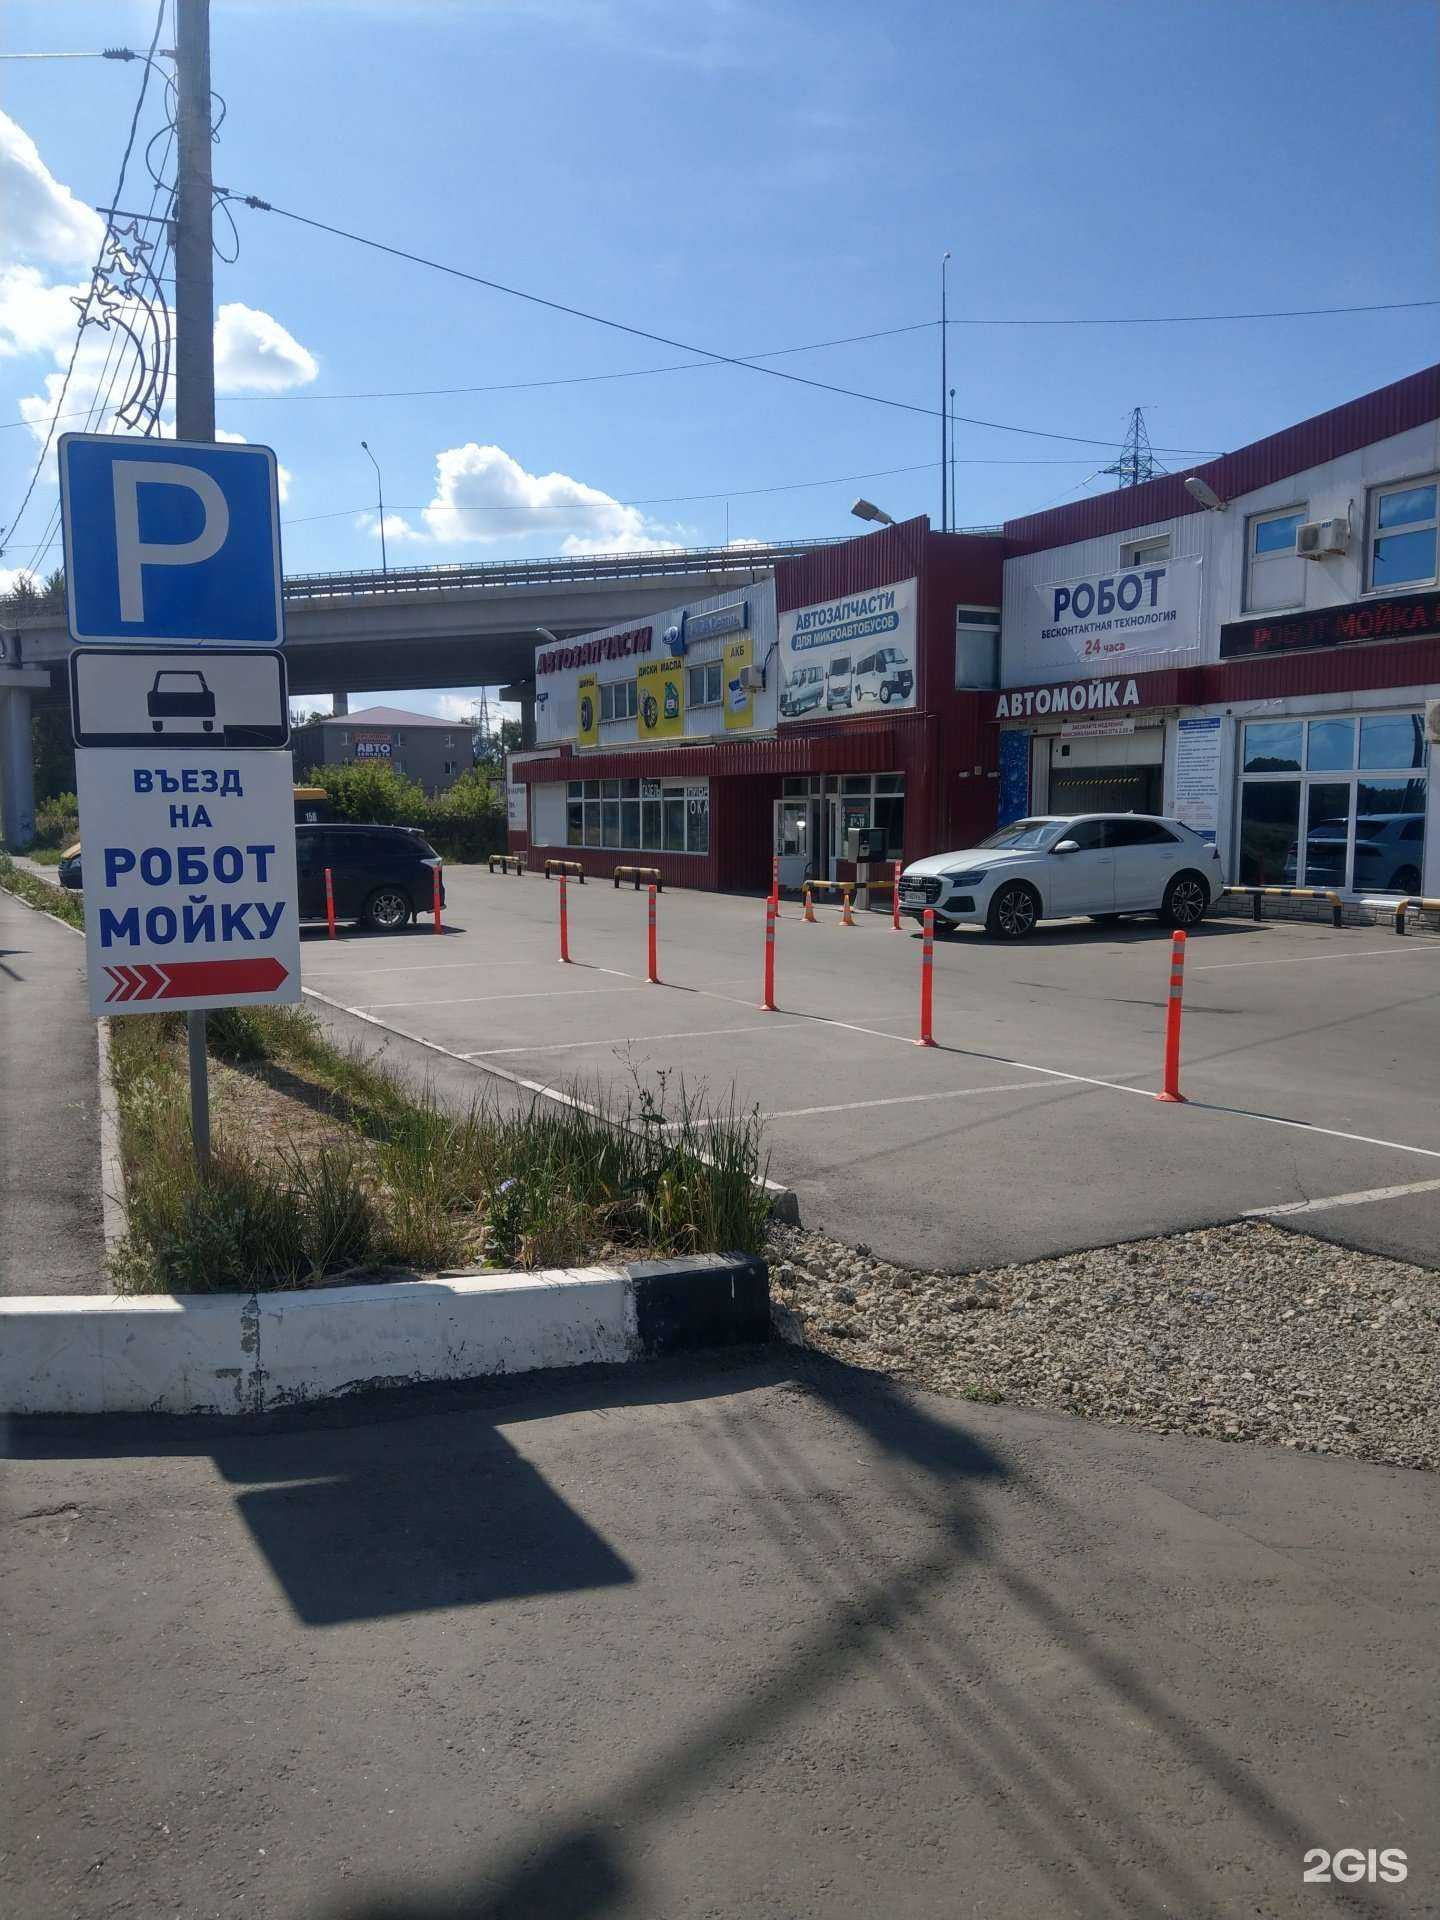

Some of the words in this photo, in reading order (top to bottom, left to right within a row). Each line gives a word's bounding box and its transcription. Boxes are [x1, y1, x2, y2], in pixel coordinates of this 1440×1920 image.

[111, 459, 230, 623] P
[795, 590, 895, 631] АВТОЗАПЧАСТИ
[1053, 568, 1166, 622] РОБОТ
[794, 635, 814, 648] ДЛЯ
[814, 615, 895, 645] МИКРОАВТОБУСОВ
[1041, 621, 1112, 639] БЕСКОНТАКТНАЯ
[1114, 610, 1177, 629] ТЕХНОЛОГИЯ
[536, 626, 652, 674] АВТОЗАПЧАСТИ
[730, 645, 745, 657] АКБ
[1084, 639, 1101, 655] 24
[1103, 642, 1126, 653] часа
[638, 665, 658, 677] ДИСКИ
[660, 660, 682, 672] МАСЛА
[996, 678, 1140, 718] АВТОМОЙКА
[357, 743, 391, 752] АВТО
[133, 768, 243, 797] ВЪЕЗД
[168, 804, 213, 829] НА
[103, 844, 276, 888] РОБОТ
[100, 896, 286, 948] МОЙКУ
